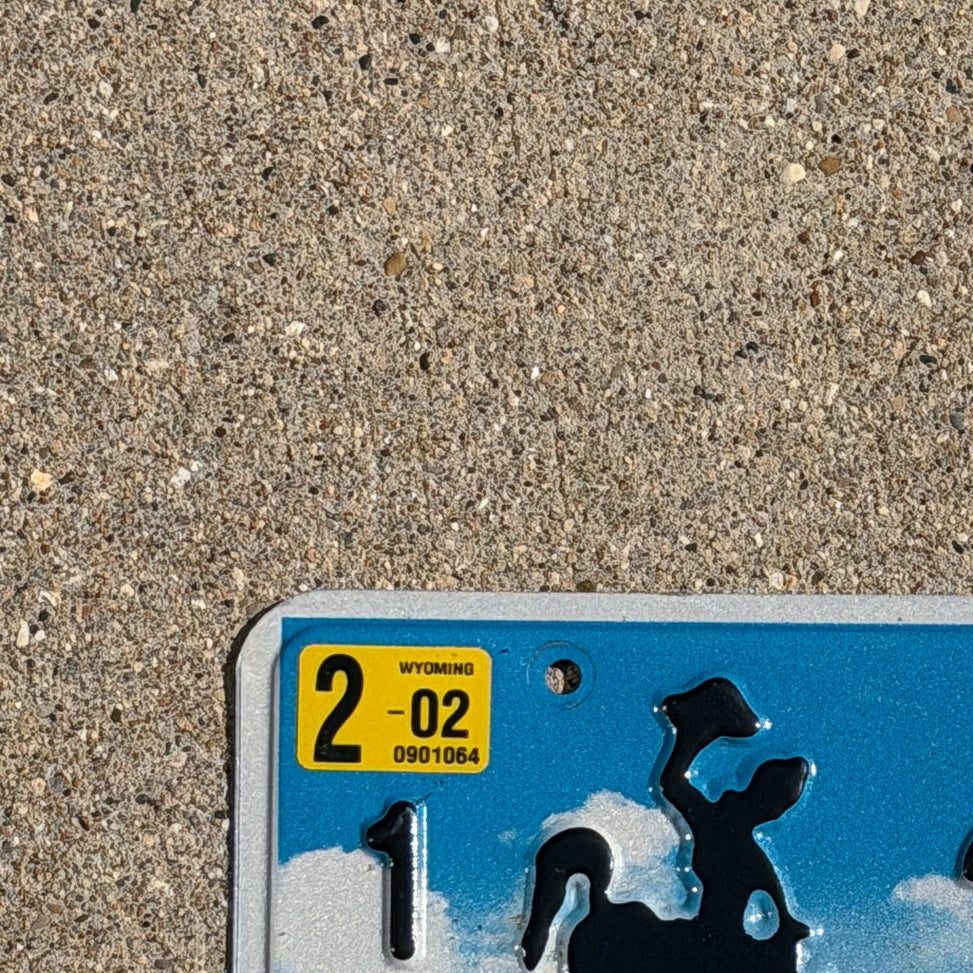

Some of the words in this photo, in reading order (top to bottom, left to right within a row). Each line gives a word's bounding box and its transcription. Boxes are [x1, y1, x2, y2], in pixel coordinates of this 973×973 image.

[399, 661, 474, 676] WYOMING
[313, 653, 364, 763] 2
[393, 745, 480, 765] 0901064
